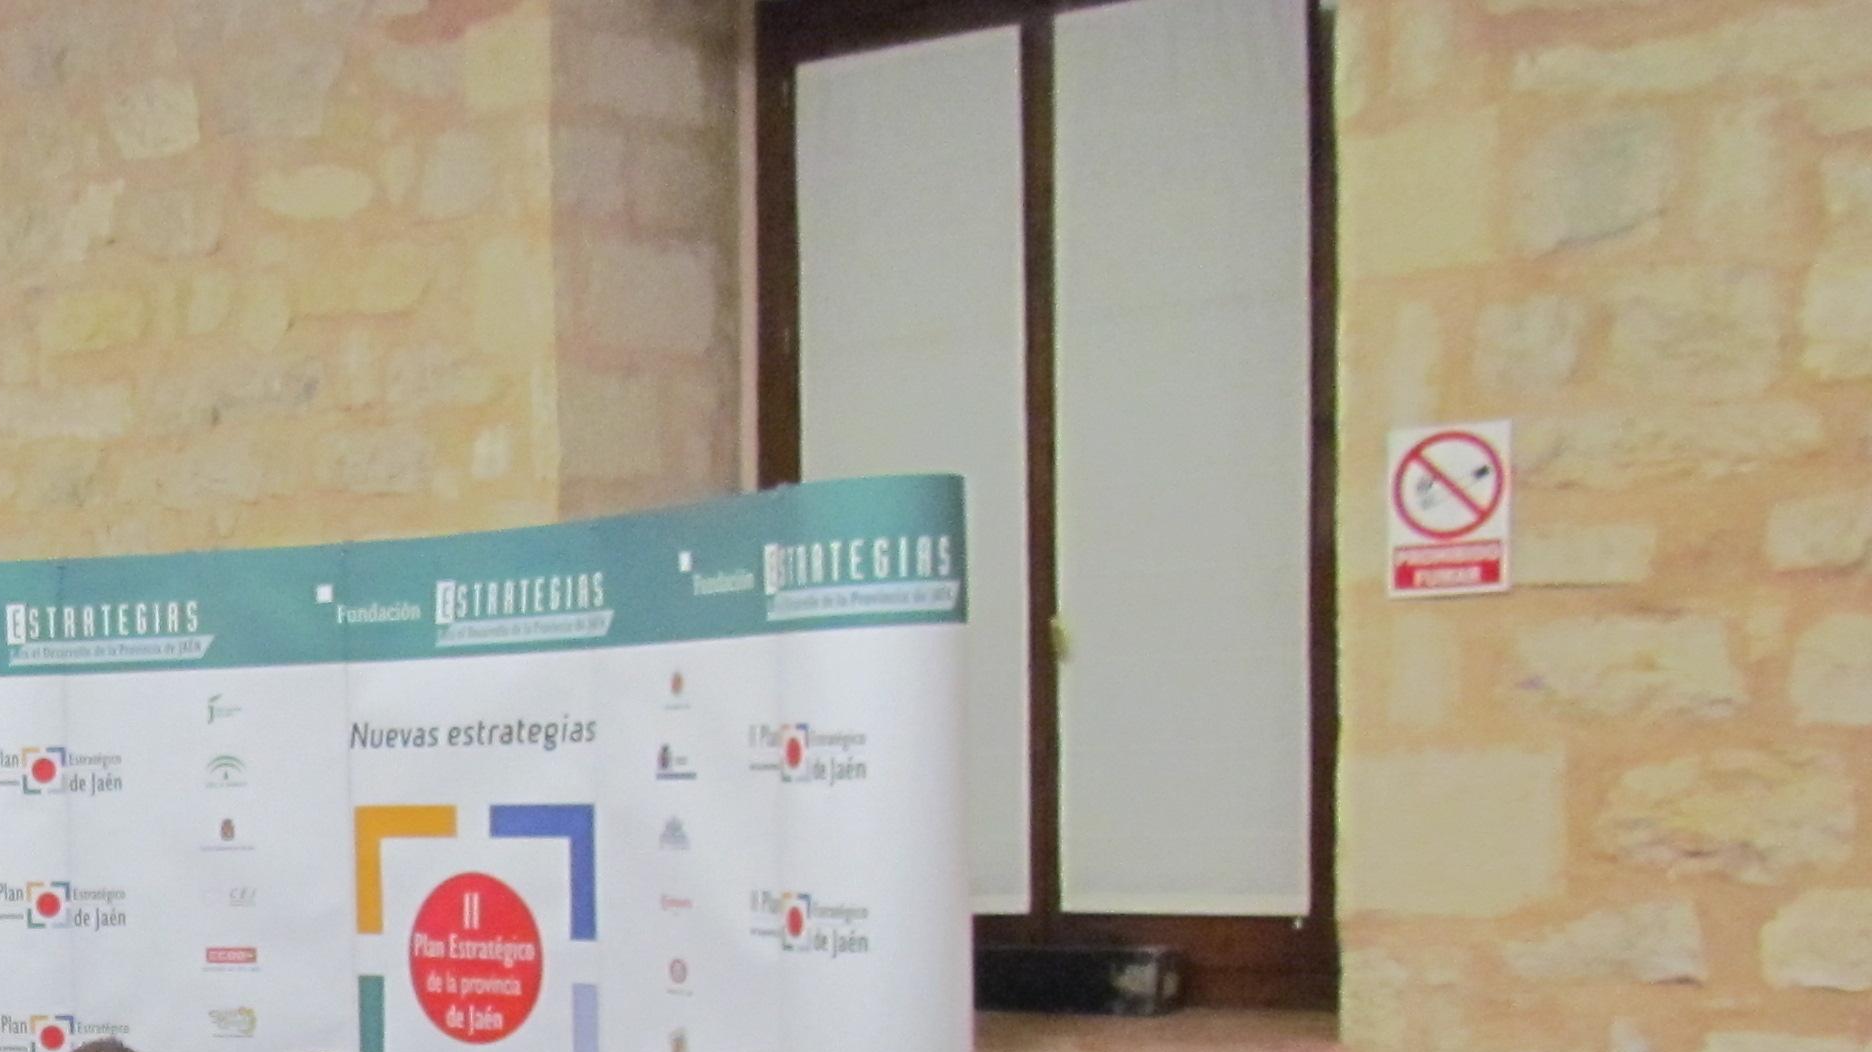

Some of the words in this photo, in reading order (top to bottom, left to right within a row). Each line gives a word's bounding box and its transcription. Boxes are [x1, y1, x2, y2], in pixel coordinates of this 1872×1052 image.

[337, 601, 422, 624] Fundación
[435, 572, 604, 625] ESTRATEGIAS
[6, 600, 199, 645] ESTRATEGIAS
[349, 722, 440, 749] Nuevas
[447, 714, 597, 751] estrategias
[70, 773, 87, 792] de
[91, 772, 123, 797] Jaén
[830, 756, 867, 787] Jaén
[73, 888, 126, 904] Estratégico
[463, 892, 479, 930] II
[74, 907, 90, 927] de
[94, 906, 127, 932] Jaén
[413, 933, 445, 957] Plan
[449, 933, 535, 968] Estratégico
[832, 928, 868, 959] Jaén
[426, 970, 443, 993] de
[446, 970, 458, 993] la
[460, 974, 522, 999] provincia
[1, 1014, 28, 1034] Plan
[445, 1004, 464, 1028] de
[467, 1004, 504, 1036] Jaén
